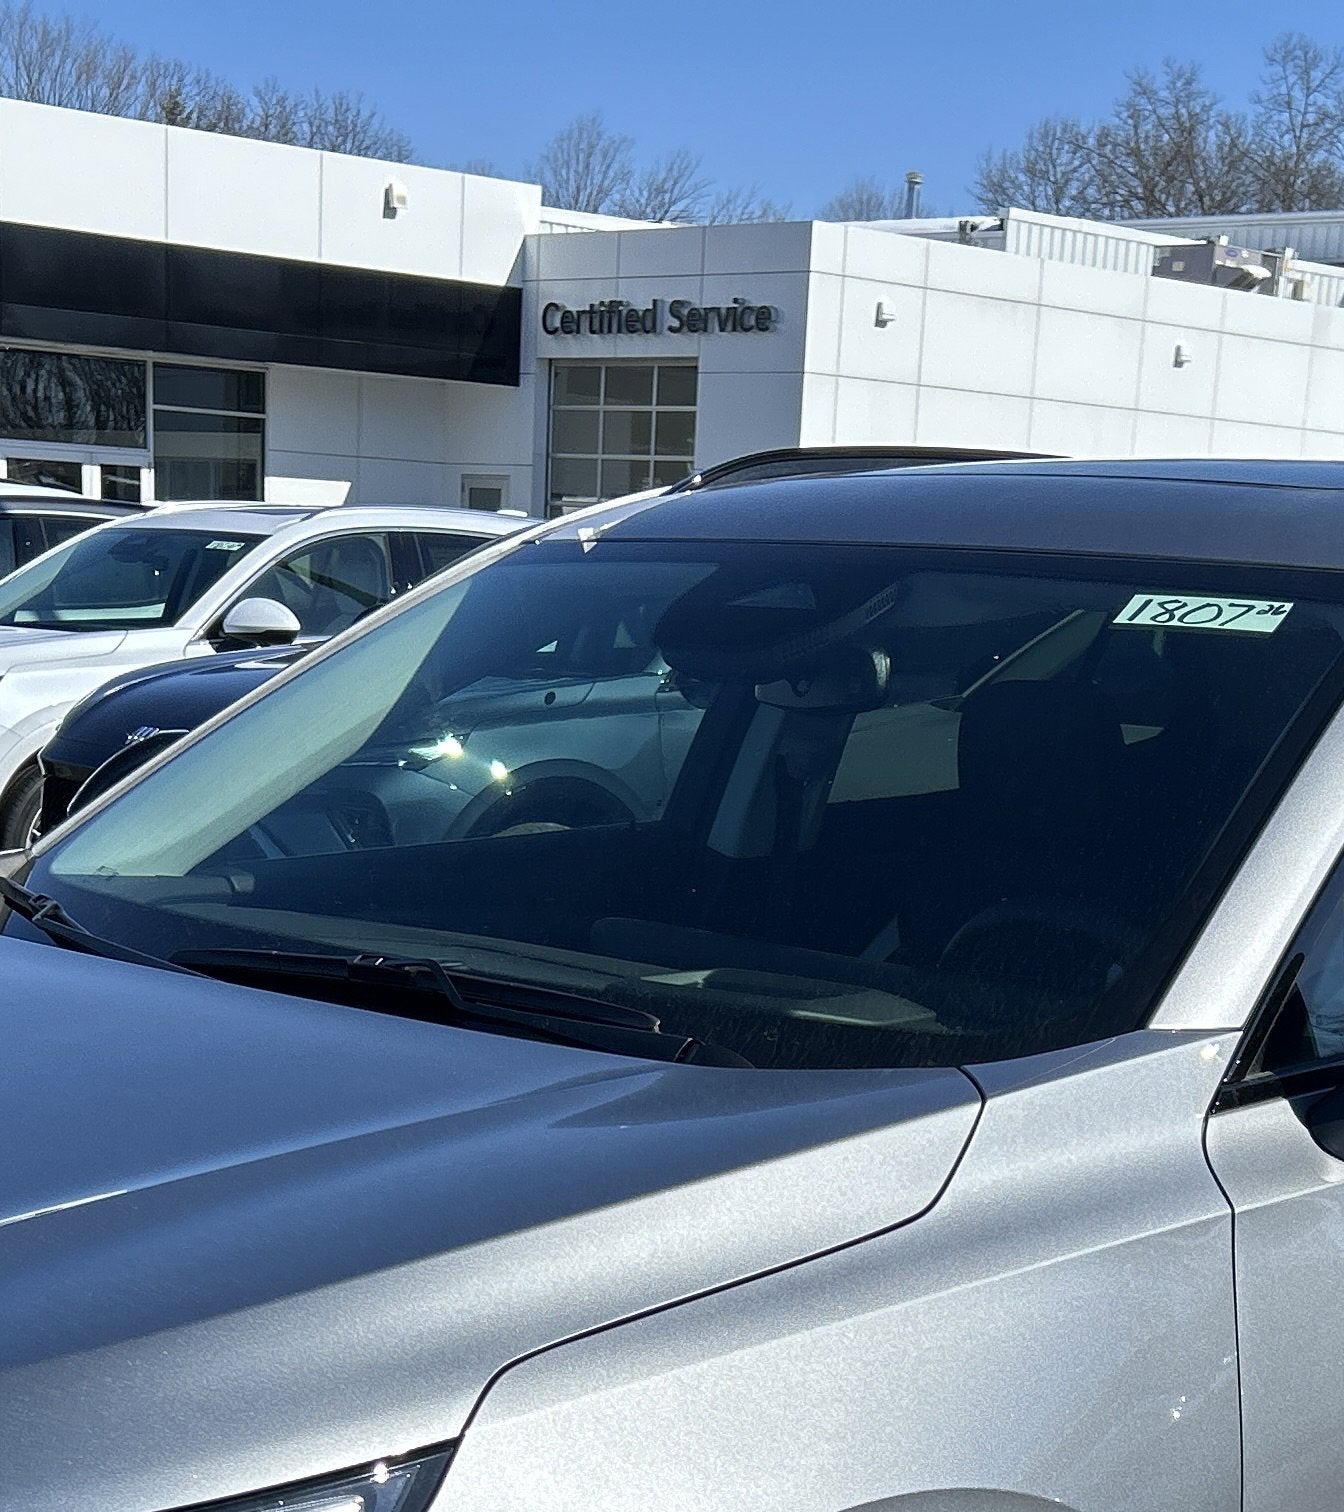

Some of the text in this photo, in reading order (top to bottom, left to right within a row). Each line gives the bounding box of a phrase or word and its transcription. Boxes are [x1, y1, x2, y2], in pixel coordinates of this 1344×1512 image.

[542, 297, 773, 335] Certified Service
[1126, 599, 1256, 626] 1807
